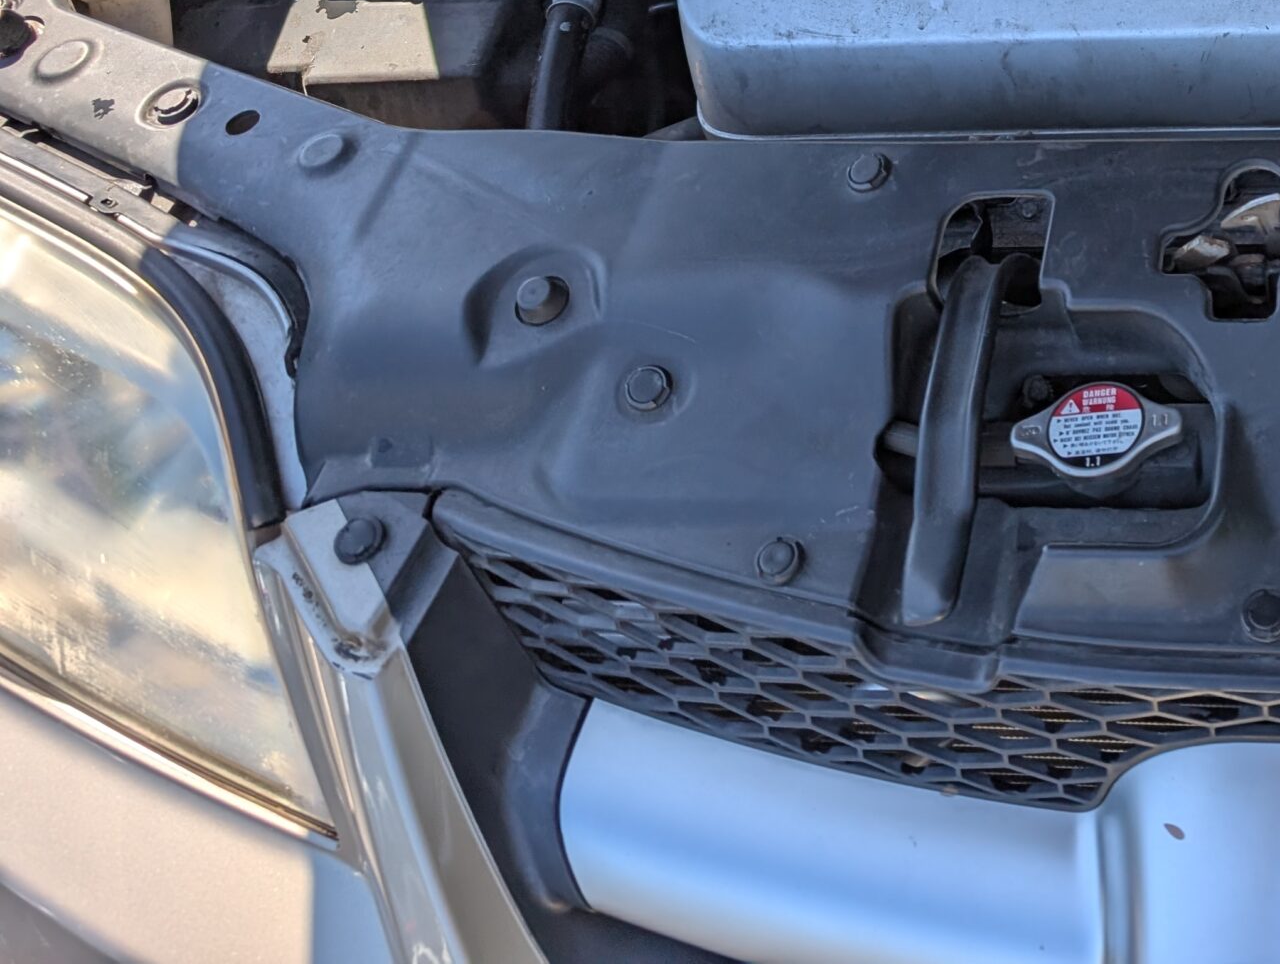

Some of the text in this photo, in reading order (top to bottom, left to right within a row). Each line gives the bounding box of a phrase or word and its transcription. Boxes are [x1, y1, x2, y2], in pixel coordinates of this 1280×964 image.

[1083, 387, 1117, 398] DANGER
[1082, 395, 1116, 406] WARNUNG
[1085, 455, 1101, 467] 1.1
